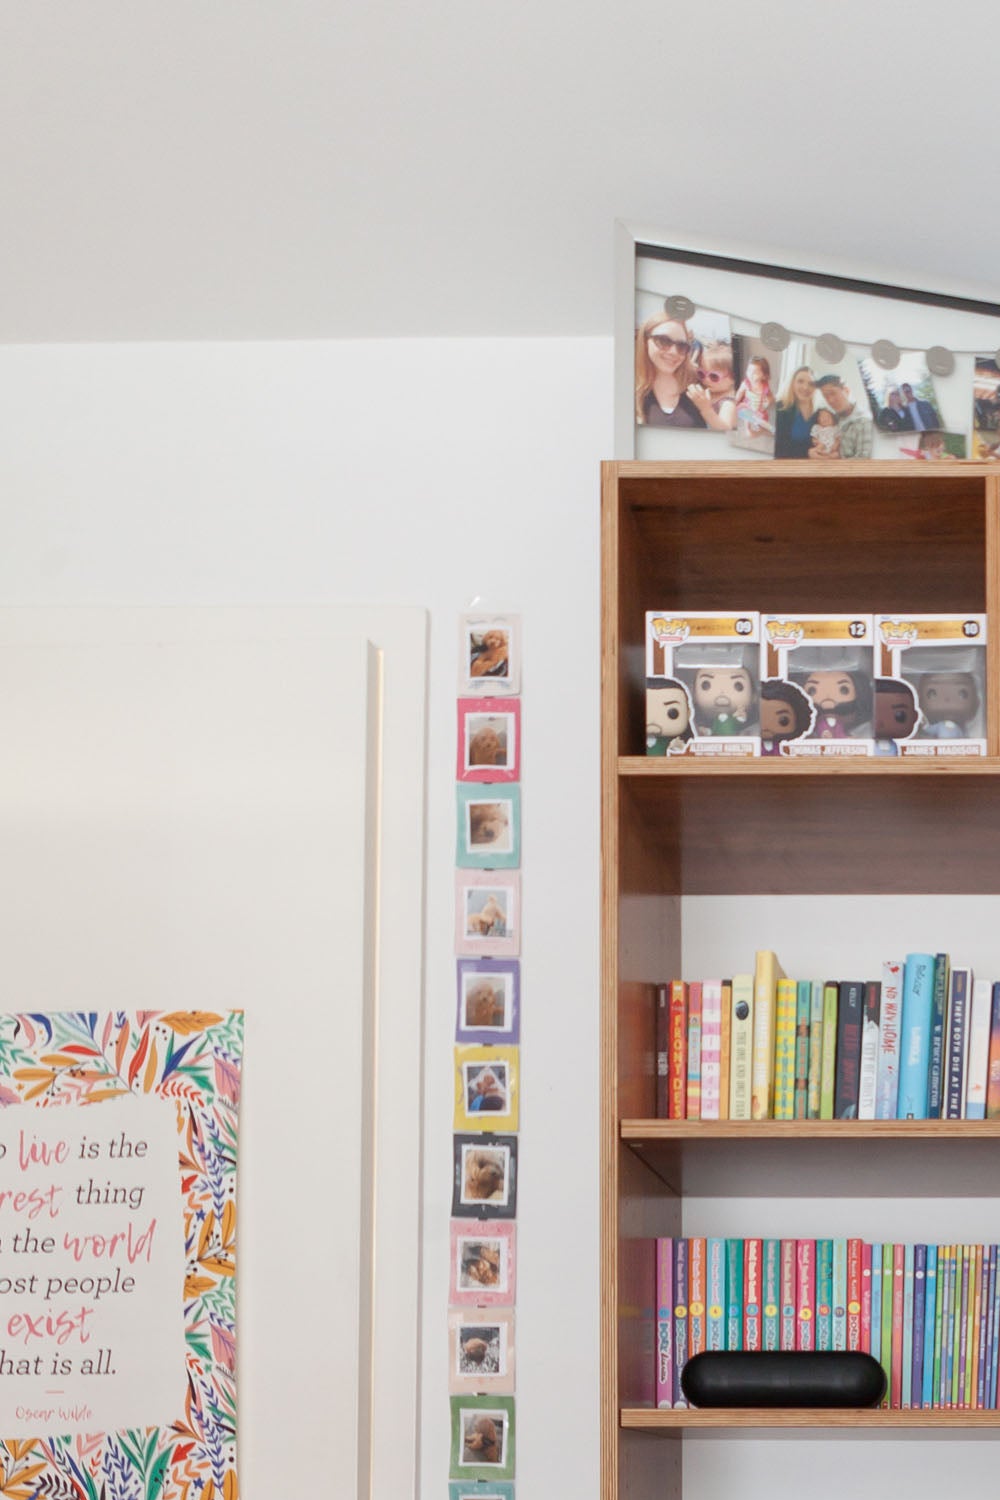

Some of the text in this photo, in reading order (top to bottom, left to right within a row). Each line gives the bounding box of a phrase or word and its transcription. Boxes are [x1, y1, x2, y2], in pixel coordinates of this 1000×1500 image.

[849, 623, 866, 637] 12
[963, 624, 978, 637] 10
[882, 986, 897, 1054] NO WAY HOME
[950, 1000, 963, 1109] THEY BOTH DIE AT THE
[17, 1129, 148, 1170] live is the
[75, 1180, 144, 1210] thing
[12, 1219, 157, 1264] the world
[44, 1268, 136, 1301] people
[7, 1307, 95, 1346] exist
[0, 1350, 117, 1376] hat is all.
